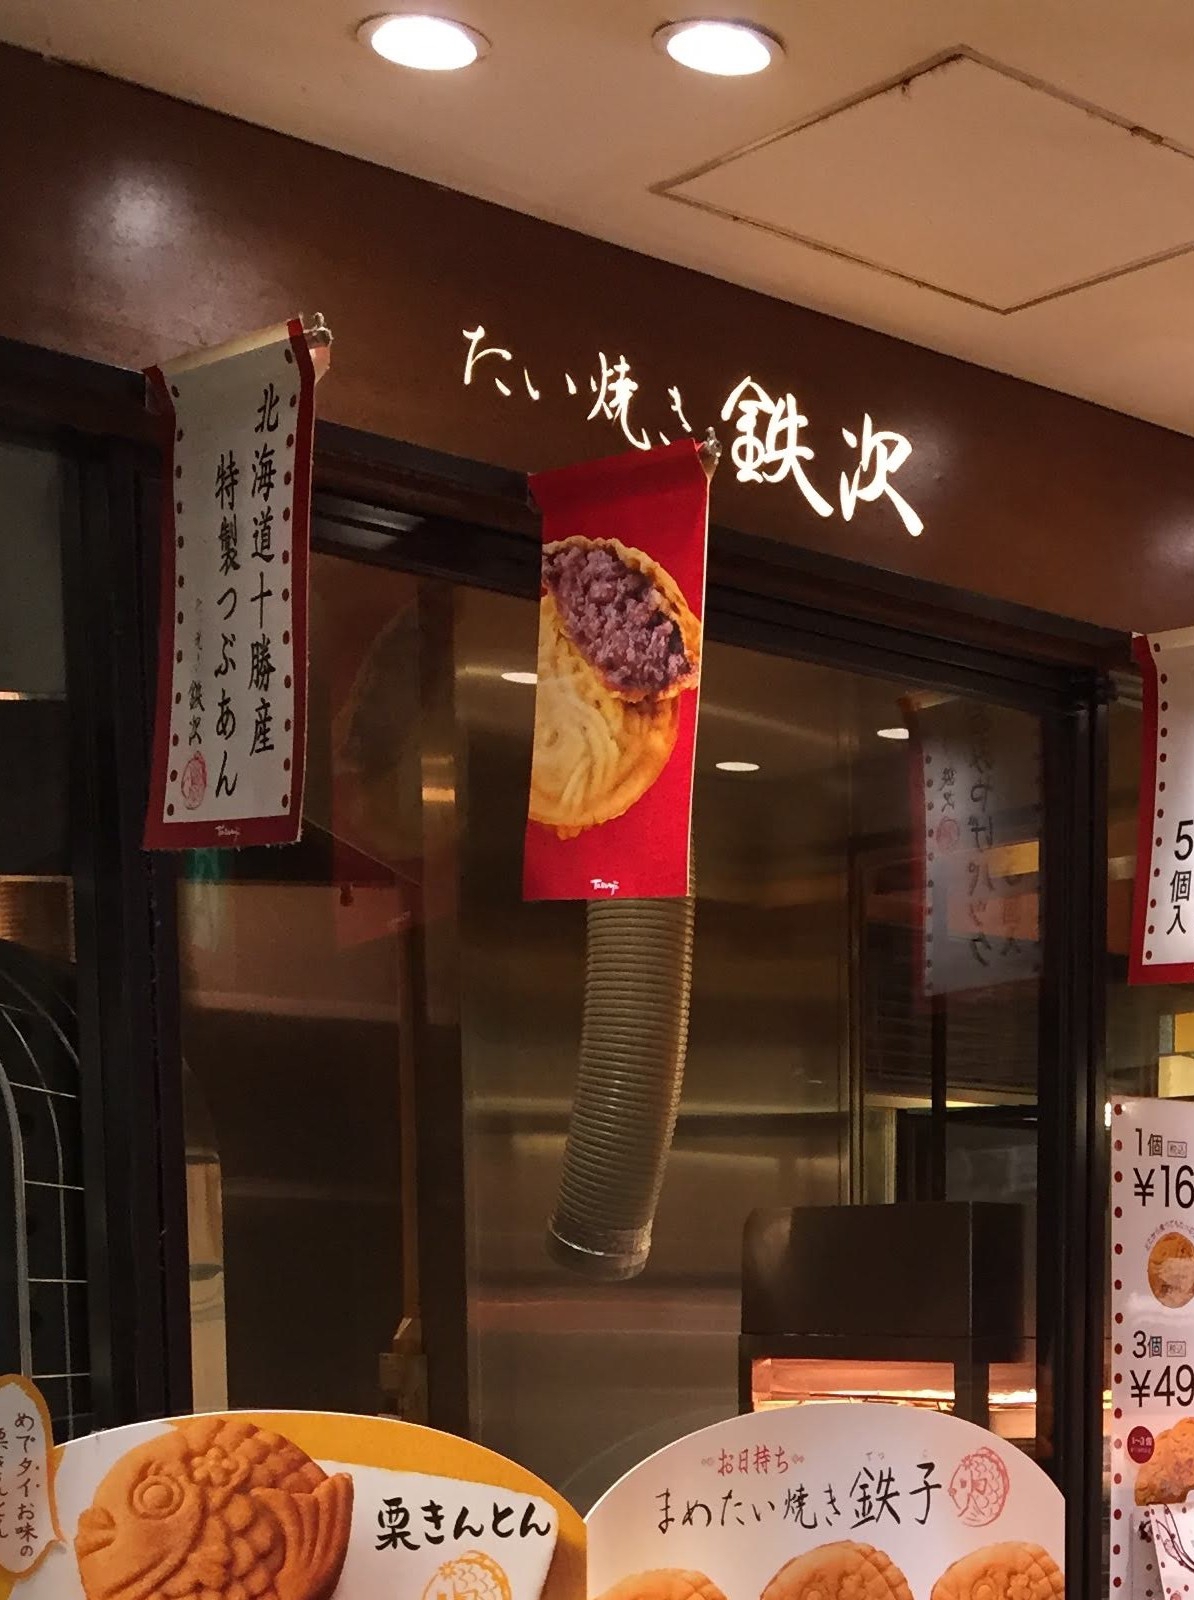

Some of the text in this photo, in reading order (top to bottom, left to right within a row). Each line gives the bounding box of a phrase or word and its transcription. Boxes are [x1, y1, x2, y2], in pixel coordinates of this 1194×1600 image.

[247, 383, 280, 757] 北海道十勝産
[214, 450, 241, 798] 特製つぶあん
[1166, 819, 1194, 936] 5個入
[655, 1461, 943, 1535] まめたい焼き鉄子
[717, 1444, 790, 1477] お日持ち
[375, 1496, 552, 1551] 栗きんとん
